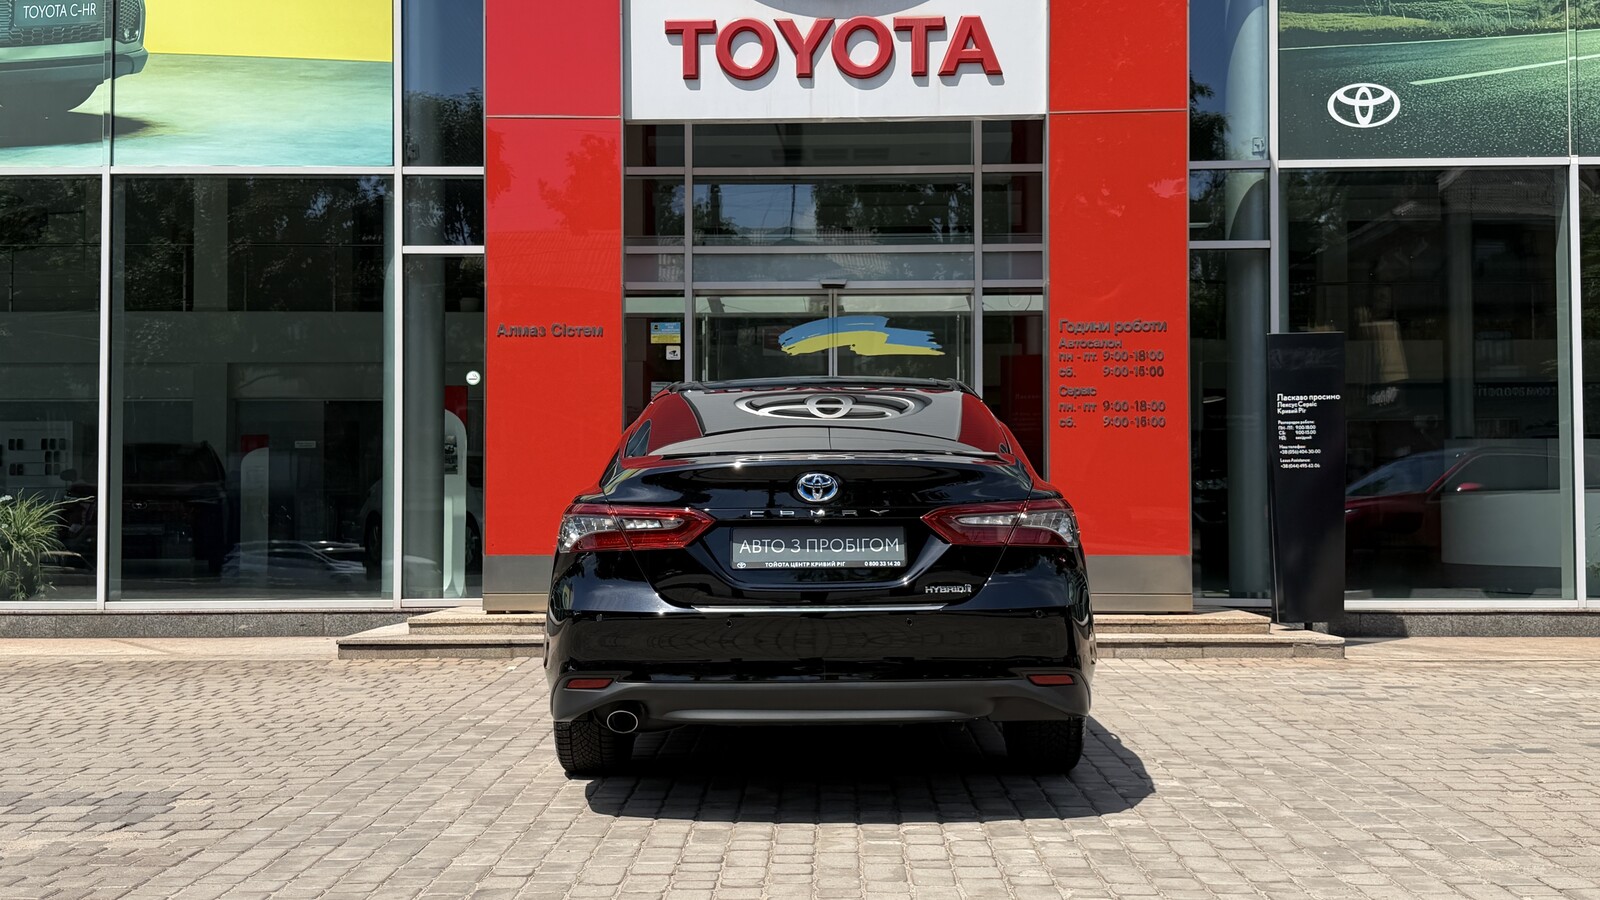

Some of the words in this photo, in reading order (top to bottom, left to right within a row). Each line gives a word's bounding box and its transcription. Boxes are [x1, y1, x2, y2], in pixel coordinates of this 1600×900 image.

[23, 5, 67, 19] TOYOTA
[70, 3, 97, 17] C-HR
[664, 15, 1003, 81] TOYOTA
[496, 323, 547, 338] Алмаз
[550, 323, 604, 338] Сістем
[1059, 320, 1111, 335] Години
[1114, 320, 1168, 336] роботи
[1058, 338, 1123, 349] Автосалон
[1103, 350, 1165, 362] 9:00-18:00
[1058, 367, 1077, 378] сб.
[1059, 385, 1097, 399] Сервіс
[1277, 393, 1308, 401] Ласкаво
[1102, 400, 1166, 413] 9:00-18:00
[1058, 417, 1077, 428] сб.
[739, 539, 785, 553] АВТО
[806, 538, 899, 552] ПРОБІГОМ
